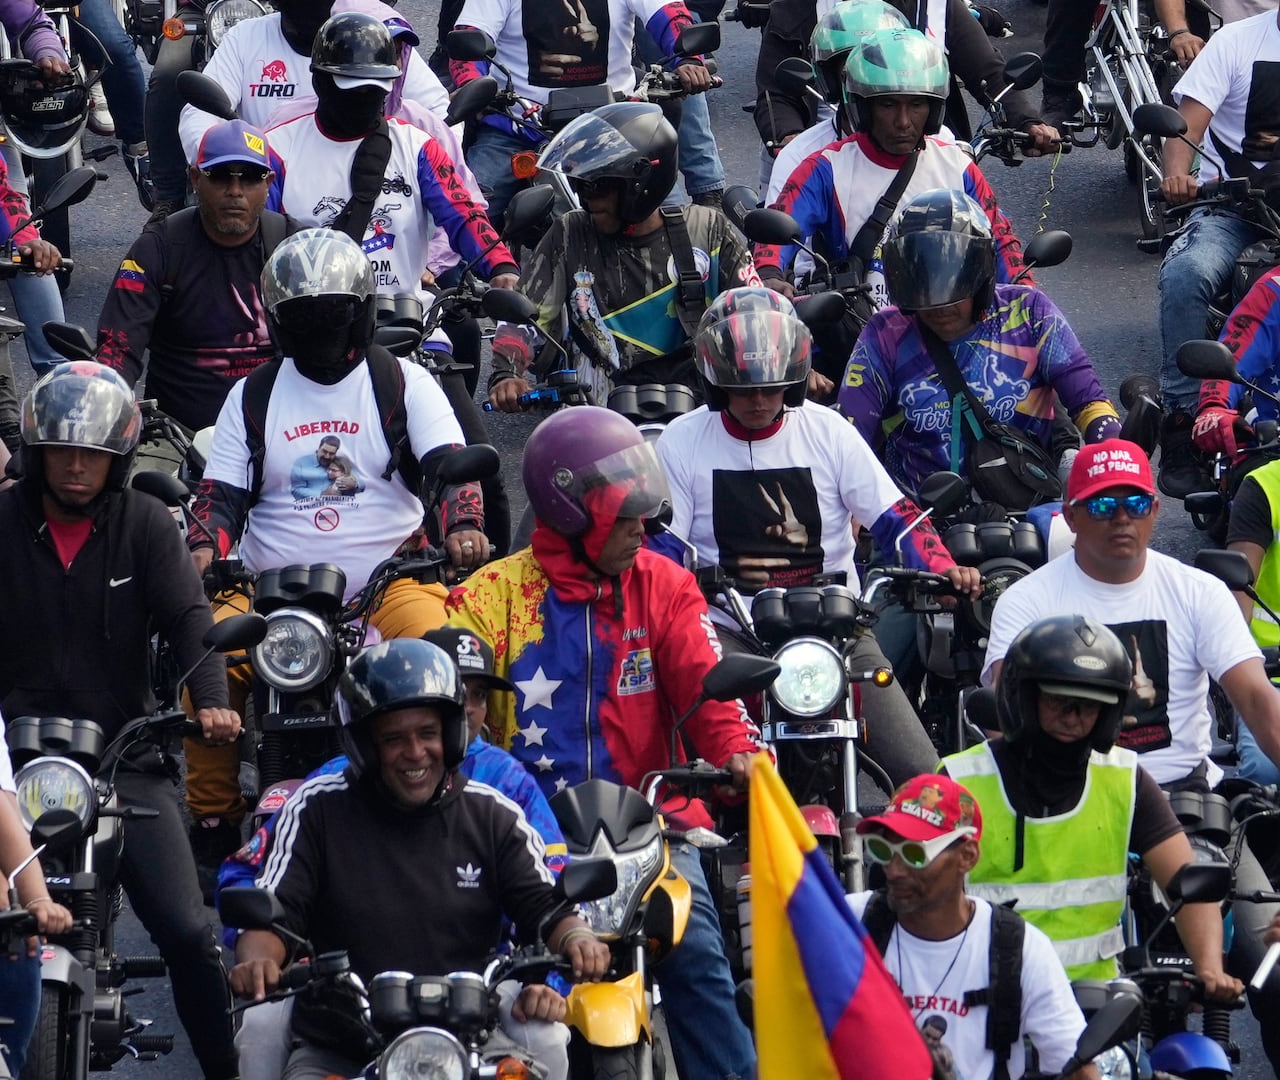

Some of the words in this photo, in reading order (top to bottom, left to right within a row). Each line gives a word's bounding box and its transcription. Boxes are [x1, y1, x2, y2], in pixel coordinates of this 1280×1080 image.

[249, 82, 297, 98] TORO
[283, 420, 360, 443] LIBERTAD
[1093, 451, 1109, 463] NO
[1087, 465, 1106, 478] YES
[900, 802, 944, 827] CHAVEZ
[45, 876, 71, 885] RA
[908, 995, 969, 1018] BERTAD
